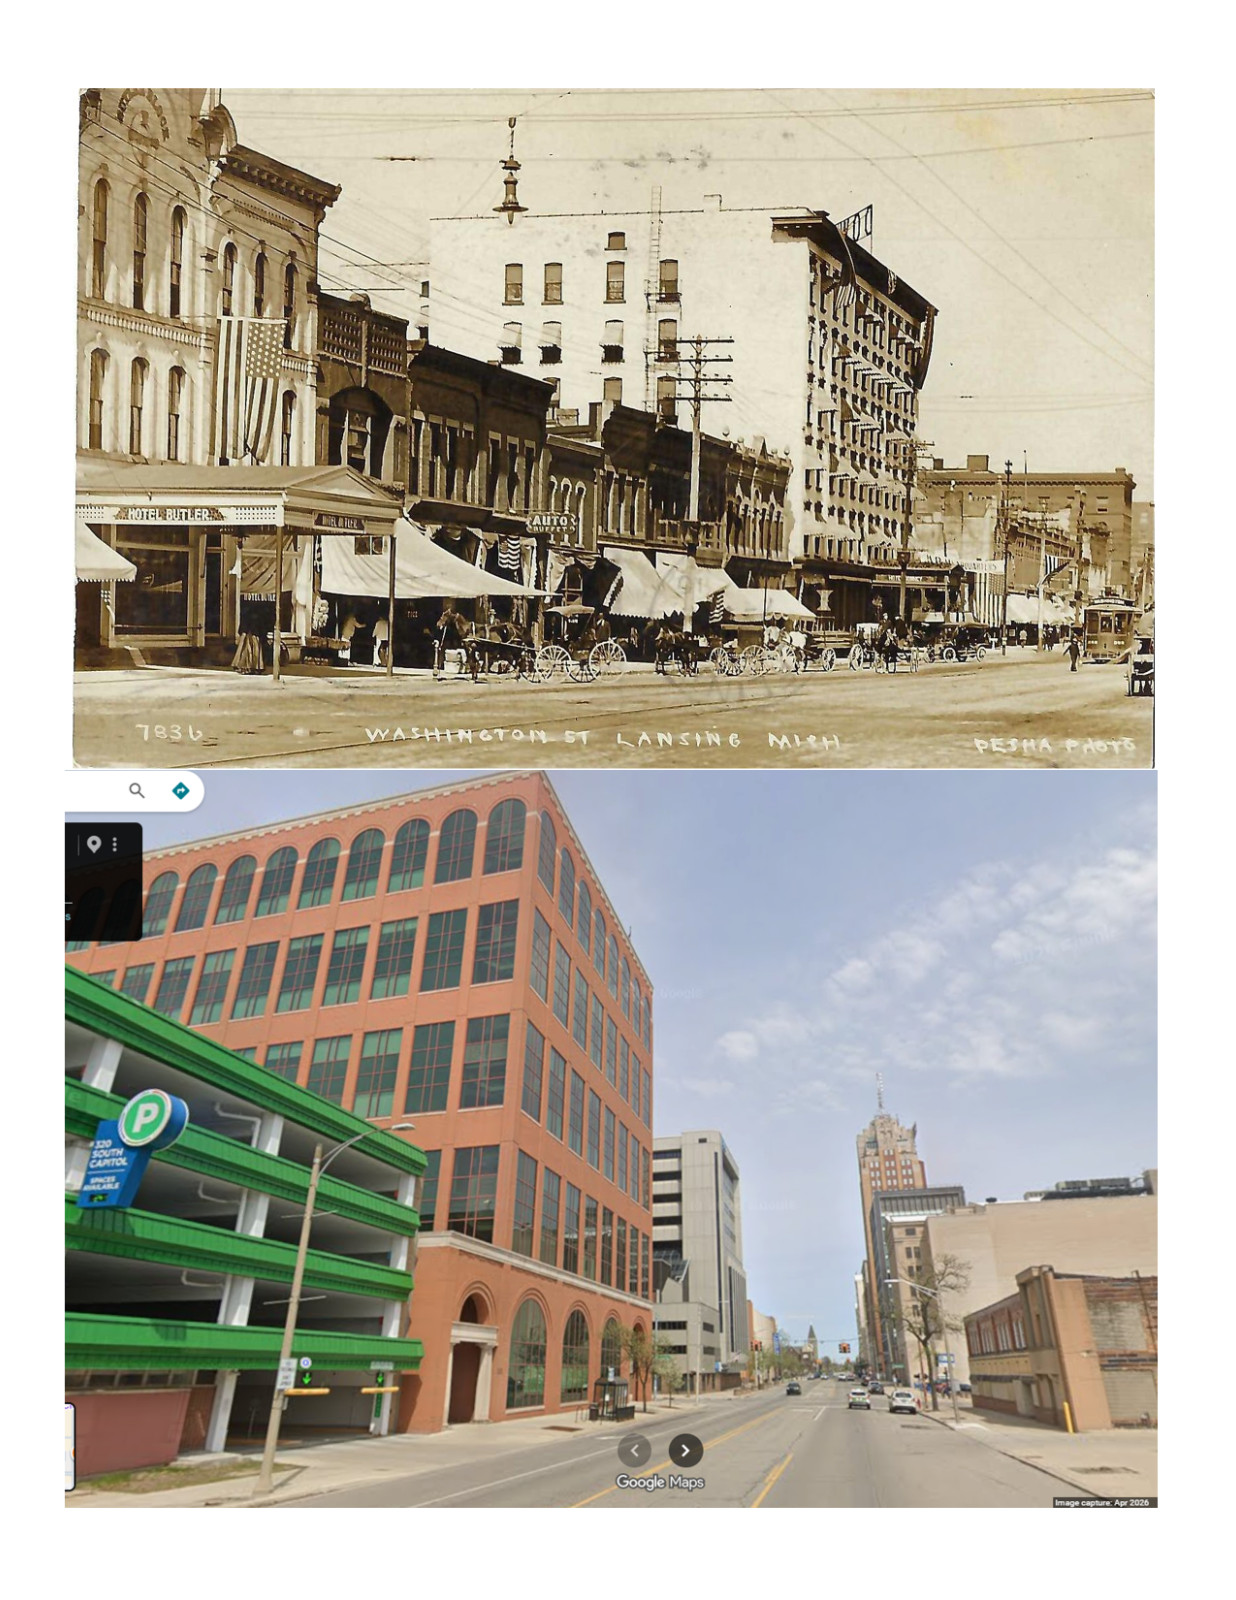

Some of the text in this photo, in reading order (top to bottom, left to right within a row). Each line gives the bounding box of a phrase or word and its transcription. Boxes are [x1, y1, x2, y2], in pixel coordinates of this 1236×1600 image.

[128, 507, 161, 520] HOTEL
[532, 515, 568, 526] AUTO
[132, 1102, 159, 1133] P
[95, 1140, 112, 1149] 320
[92, 1148, 124, 1159] SOUTH
[89, 1157, 128, 1168] CAPITOL
[90, 1176, 116, 1184] SPACES
[83, 1182, 120, 1191] AVAILABLE
